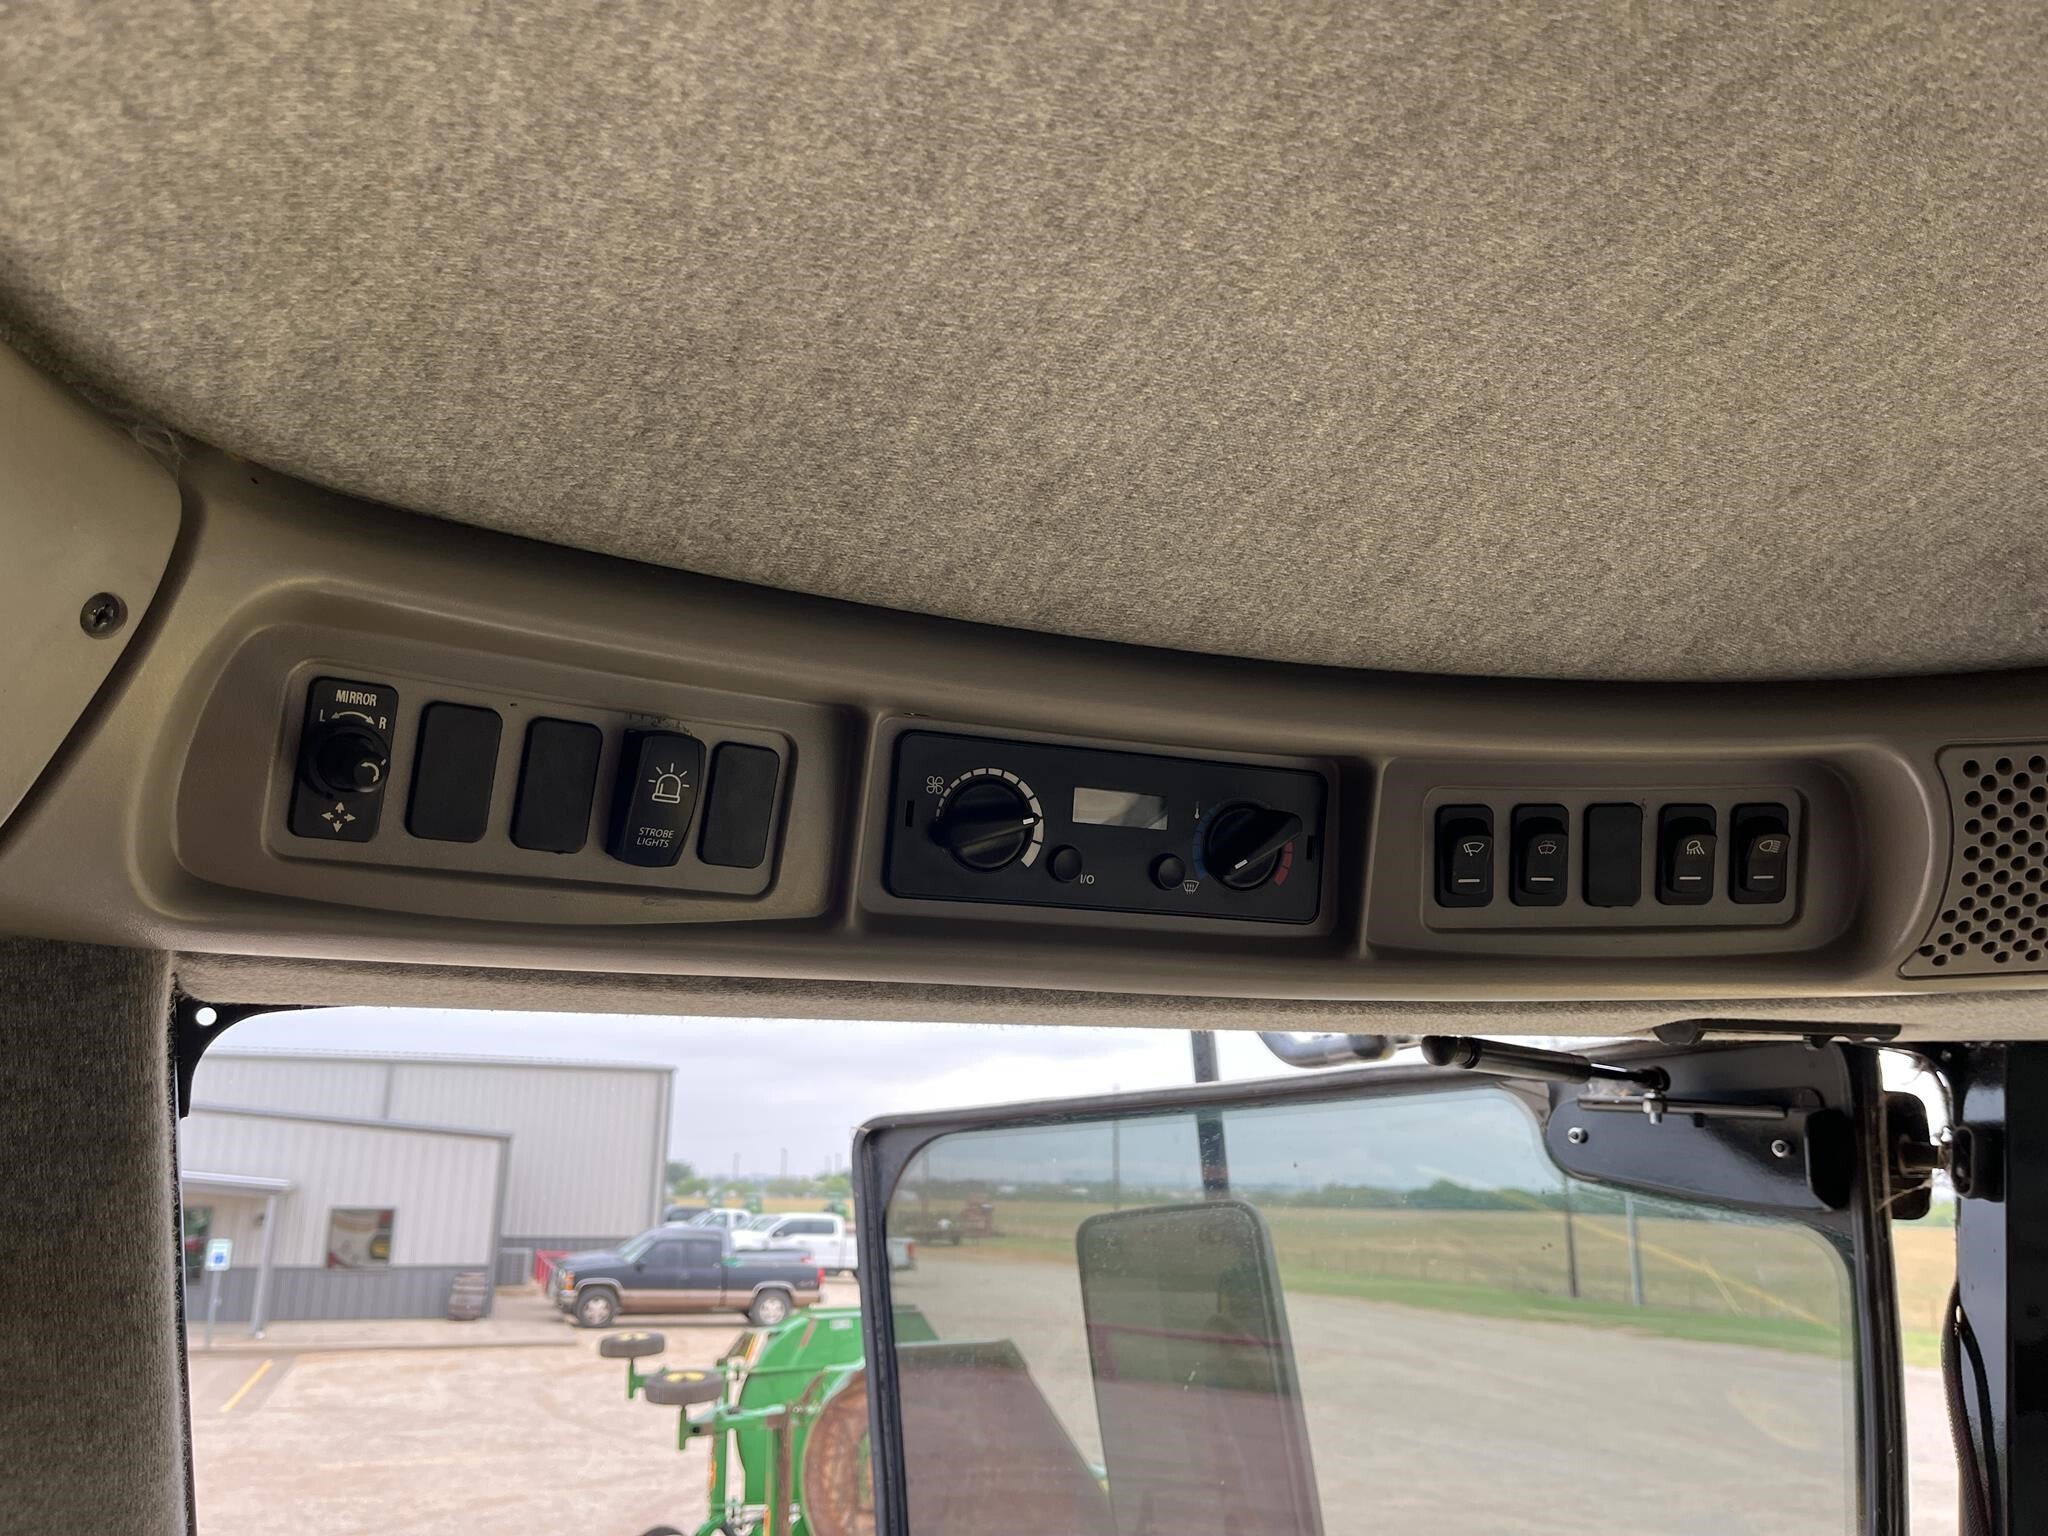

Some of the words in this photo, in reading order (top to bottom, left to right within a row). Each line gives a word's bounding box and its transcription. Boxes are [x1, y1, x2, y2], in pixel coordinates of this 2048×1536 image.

[336, 689, 377, 706] MIRROR
[319, 709, 326, 722] L
[378, 717, 387, 730] R
[638, 827, 675, 839] STROBE
[636, 837, 670, 848] LIGHTS
[1080, 874, 1095, 885] I/O
